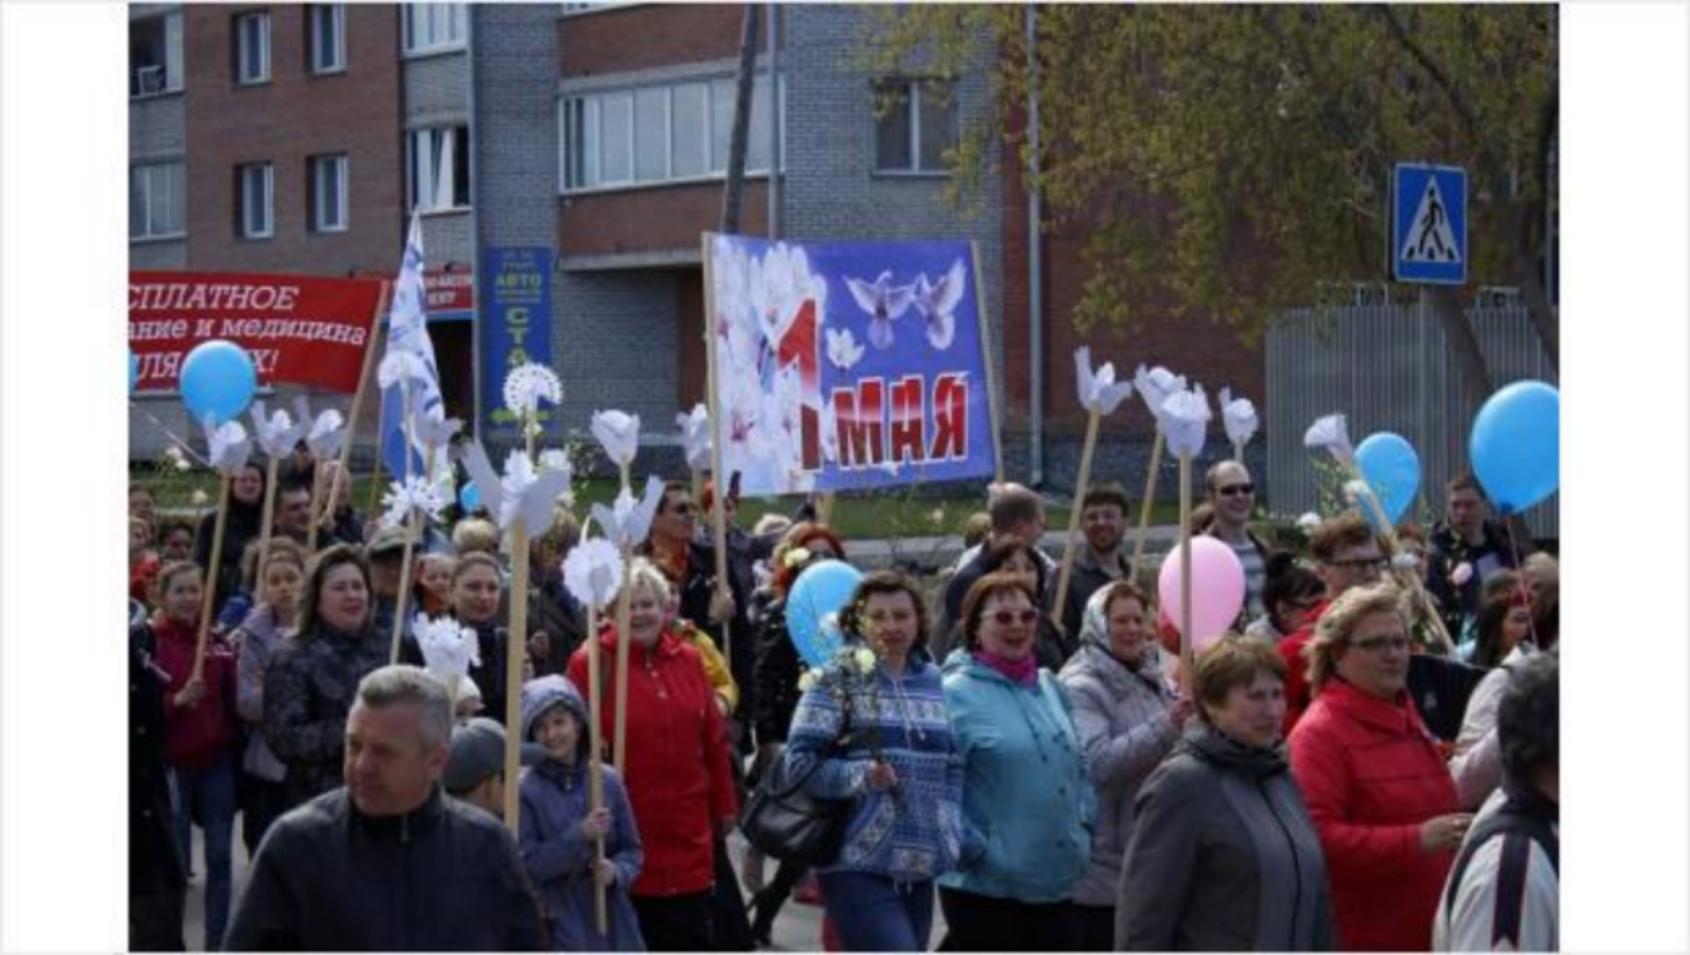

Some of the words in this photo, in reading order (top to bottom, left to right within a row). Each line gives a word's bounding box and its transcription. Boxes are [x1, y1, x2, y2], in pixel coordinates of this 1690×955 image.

[194, 319, 213, 337] и
[221, 317, 366, 345] медицина
[831, 373, 968, 470] МАЯ
